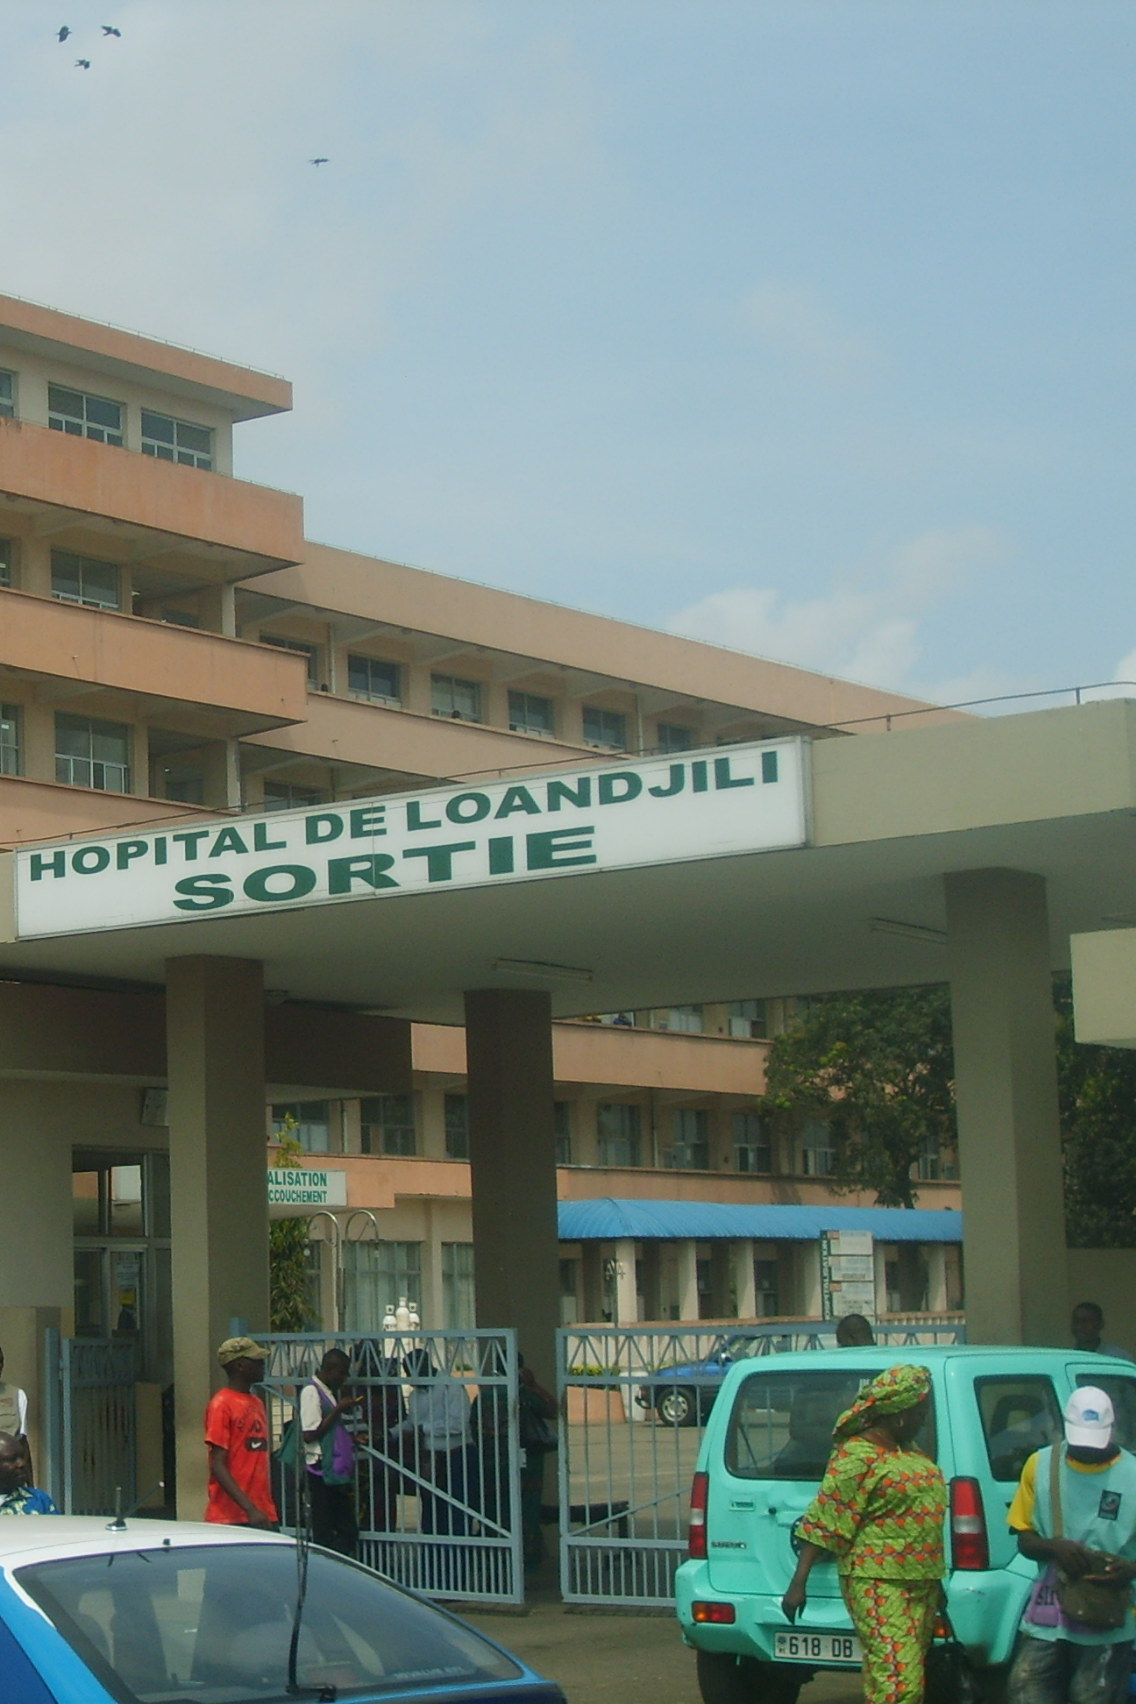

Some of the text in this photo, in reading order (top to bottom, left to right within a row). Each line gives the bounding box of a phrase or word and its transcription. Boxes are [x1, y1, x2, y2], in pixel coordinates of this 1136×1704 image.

[30, 750, 778, 882] HOPITAL DE LOANDJILI
[172, 825, 597, 911] SORTIE
[789, 1636, 853, 1658] 618 DB
